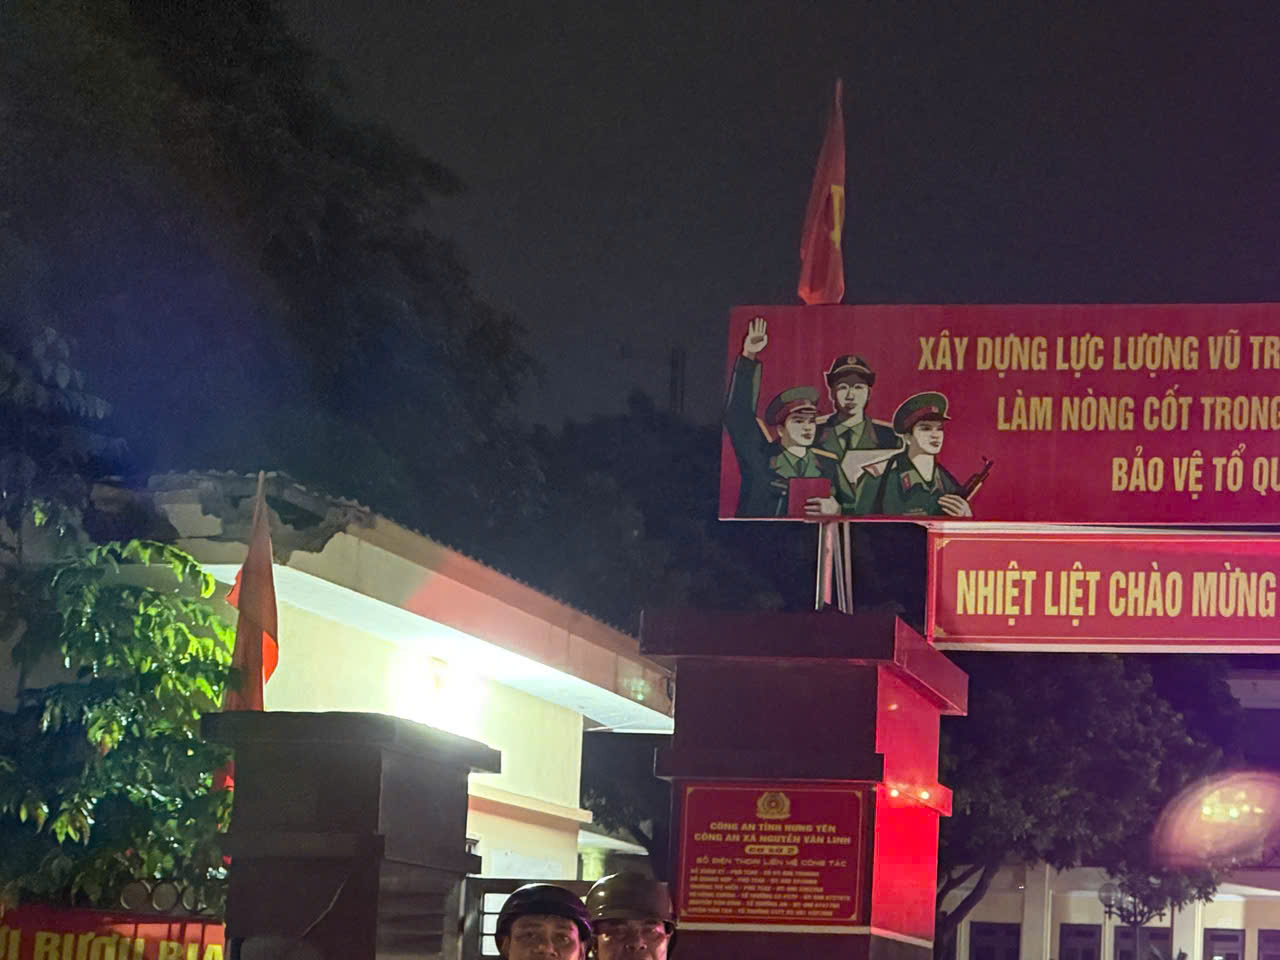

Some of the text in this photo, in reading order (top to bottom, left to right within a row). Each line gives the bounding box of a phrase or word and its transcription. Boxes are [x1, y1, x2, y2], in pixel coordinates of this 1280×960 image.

[918, 330, 968, 371] XÂY
[976, 332, 1047, 379] DỰNG
[1055, 332, 1105, 379] LỰC
[1112, 332, 1199, 378] LƯỢNG
[1207, 329, 1241, 370] VŨ
[997, 388, 1053, 431] LÀM
[1061, 387, 1135, 431] NÒNG
[1143, 384, 1193, 432] CỐT
[1112, 445, 1165, 492] BẢO
[1172, 449, 1204, 500] VỆ
[1212, 445, 1247, 492] TỔ
[955, 561, 1037, 627] NHIỆT
[1044, 561, 1101, 627] LIỆT
[1108, 561, 1183, 618] CHÀO
[1191, 561, 1277, 618] MỪNG
